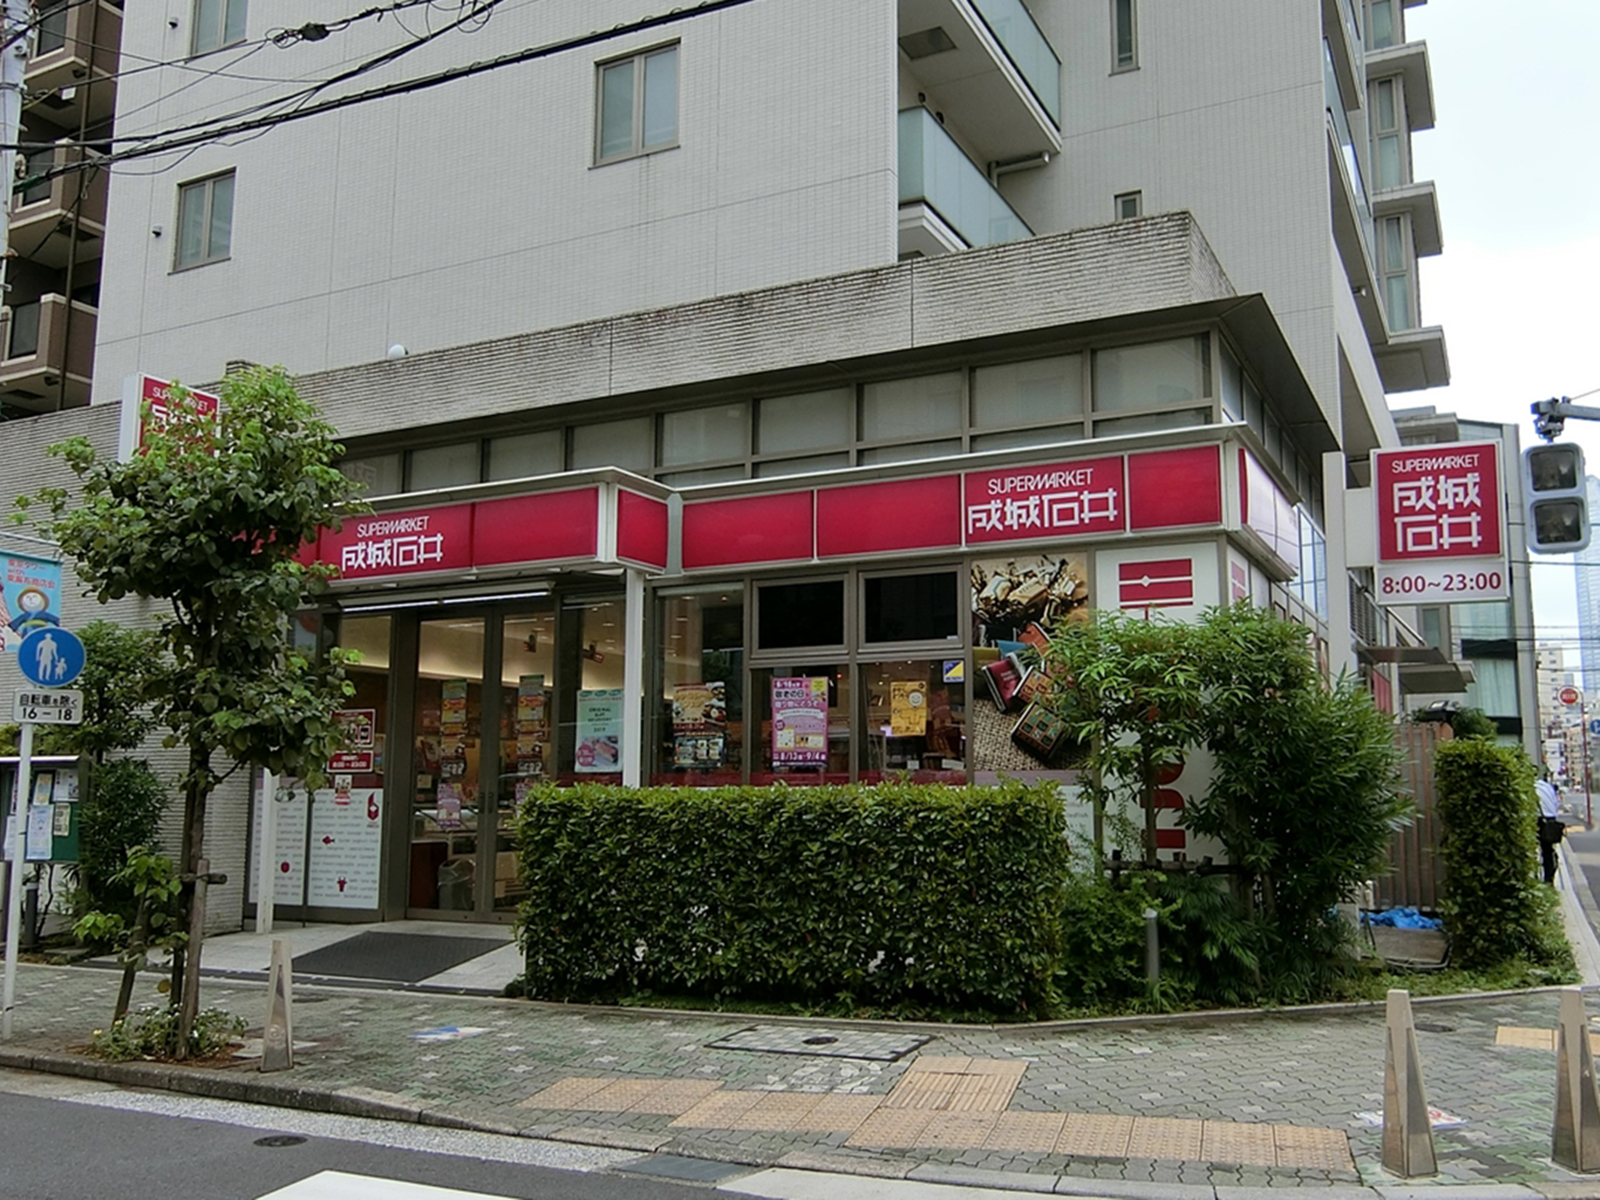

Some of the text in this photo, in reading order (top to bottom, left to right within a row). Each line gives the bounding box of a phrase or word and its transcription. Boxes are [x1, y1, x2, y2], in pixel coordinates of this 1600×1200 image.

[1391, 453, 1480, 474] SUPERMARKET
[987, 468, 1094, 495] SUPERMARKET
[1393, 472, 1482, 514] 成城
[357, 515, 430, 538] SUPERMARKET
[967, 487, 1118, 535] 成城石井
[1393, 512, 1482, 553] 石井
[341, 533, 444, 572] 成城石井
[20, 693, 78, 708] 自転車を除く
